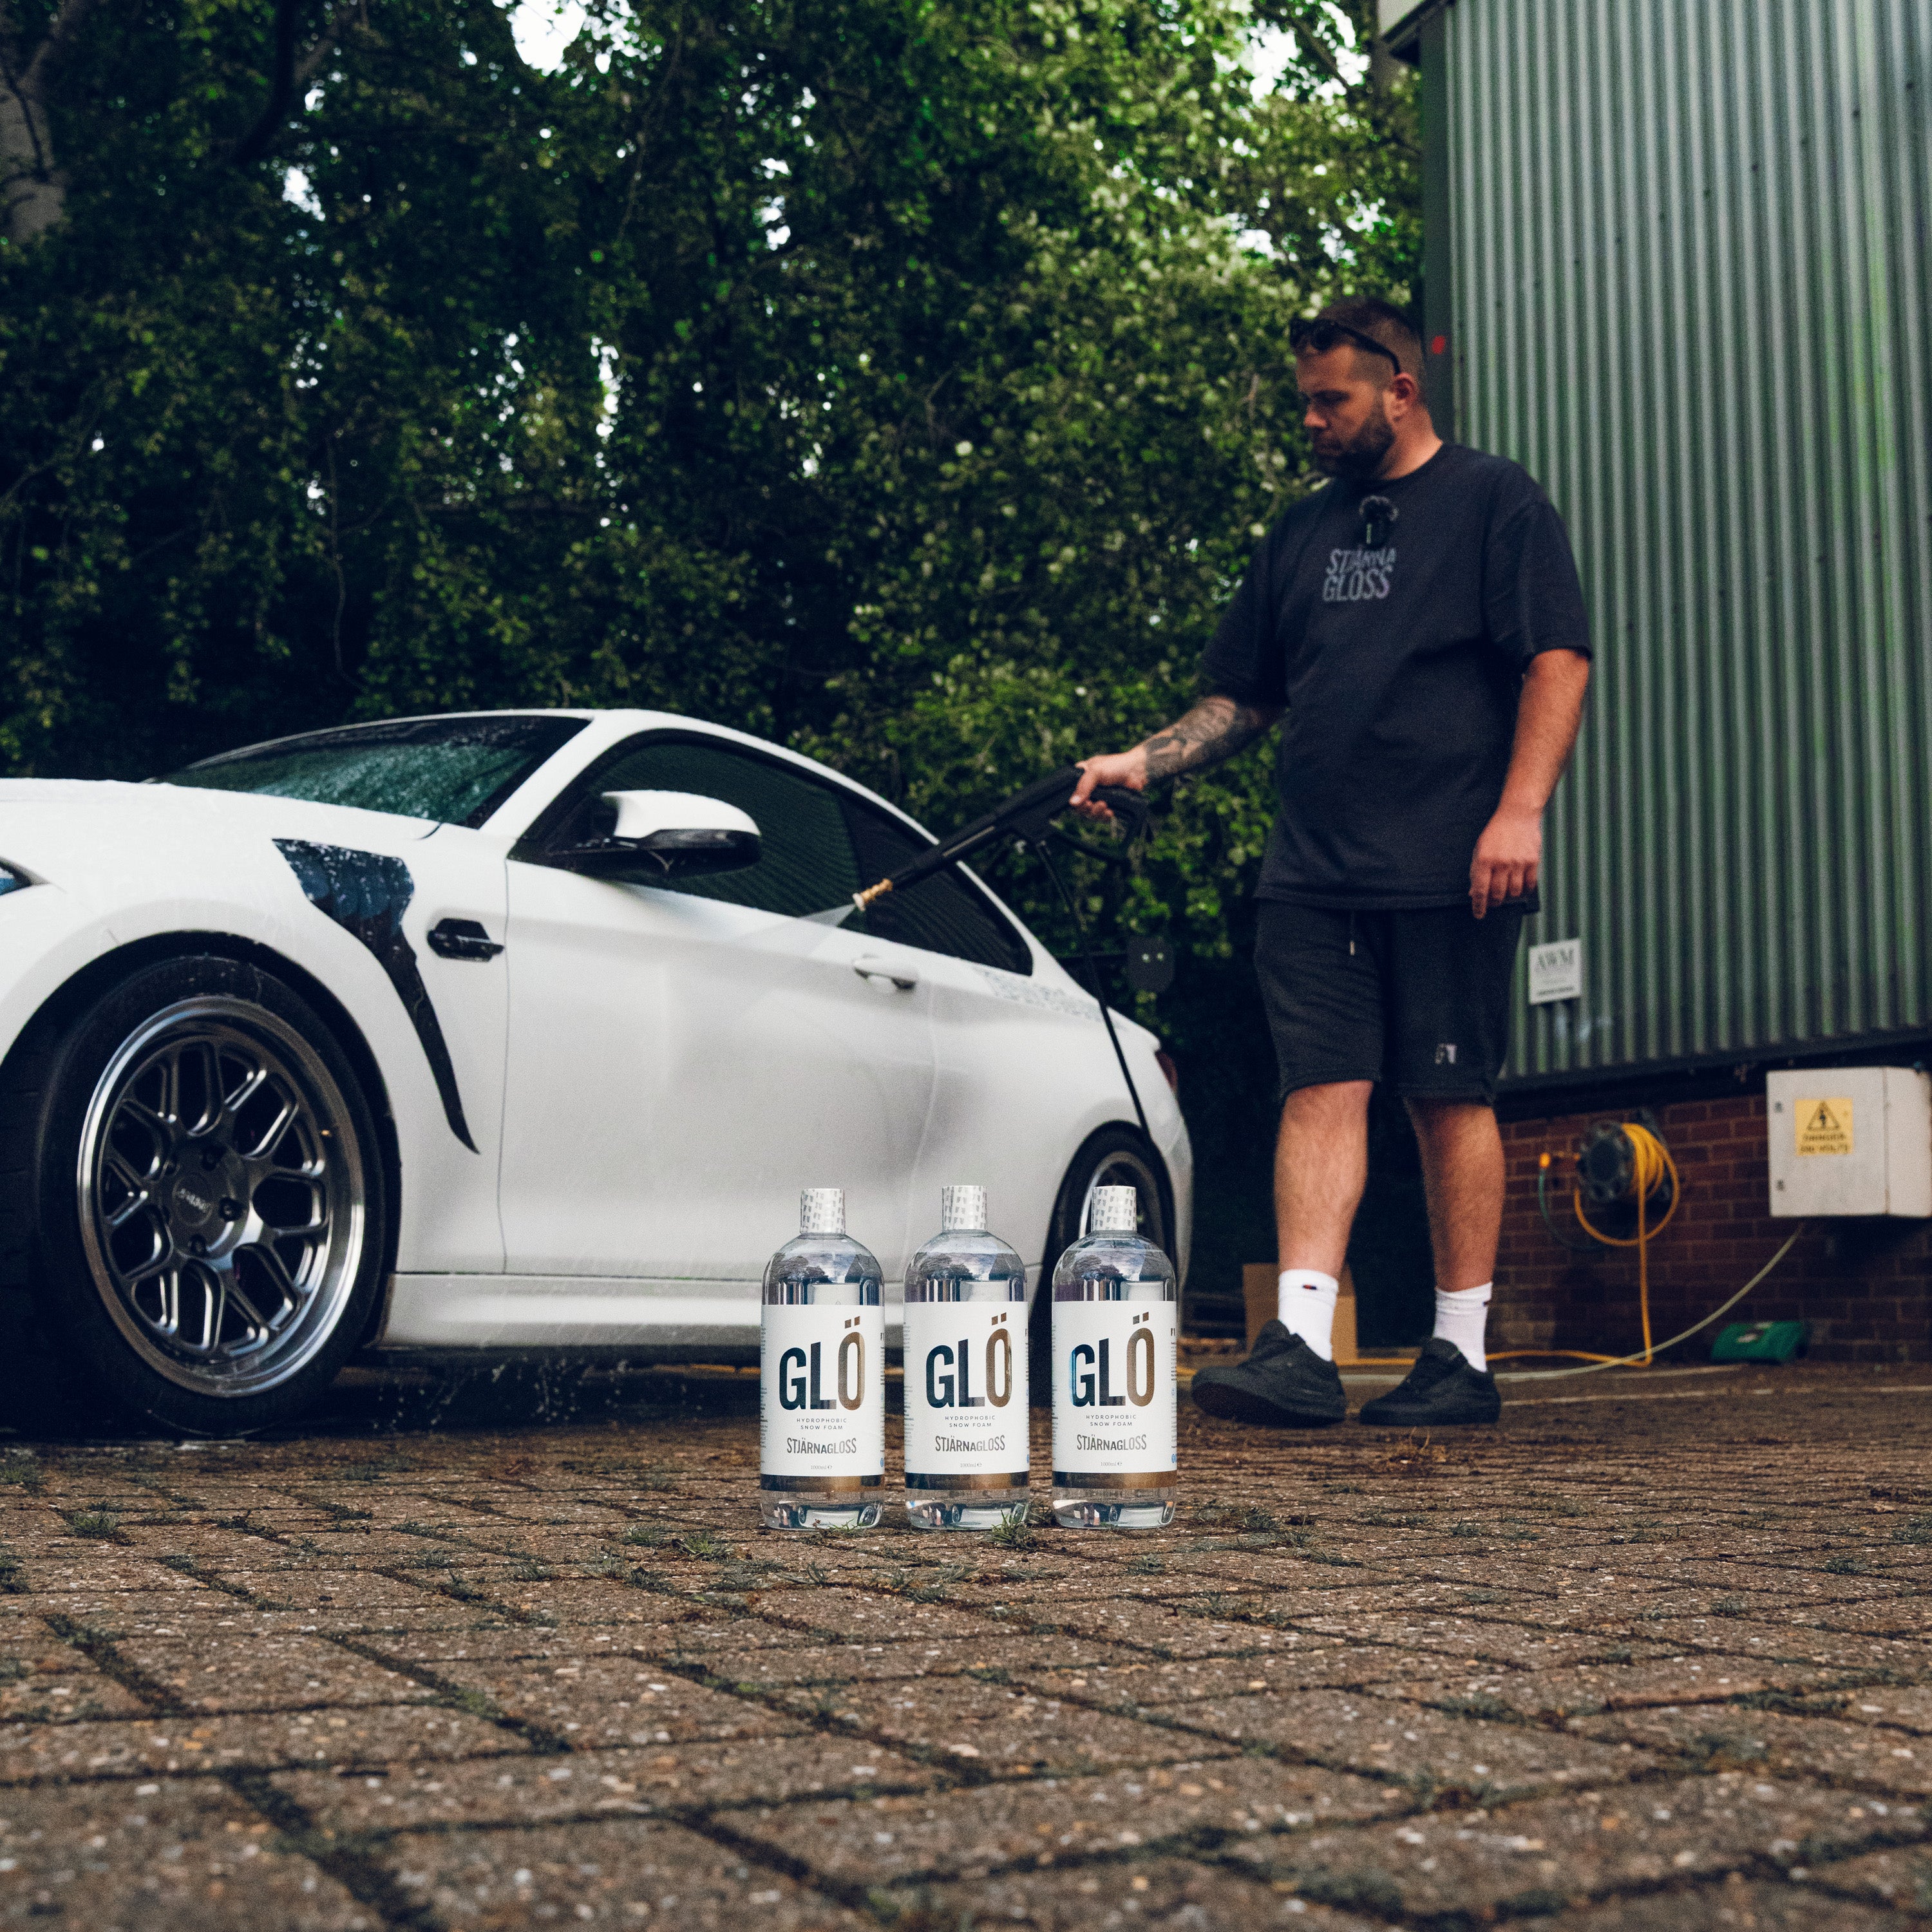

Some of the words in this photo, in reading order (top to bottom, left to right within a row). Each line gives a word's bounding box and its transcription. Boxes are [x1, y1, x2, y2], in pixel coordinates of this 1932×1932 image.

[1322, 565, 1393, 602] GLOSS
[779, 1316, 866, 1410] GLÖ
[925, 1312, 1012, 1408] GLÖ
[1069, 1311, 1155, 1407] GLÖ
